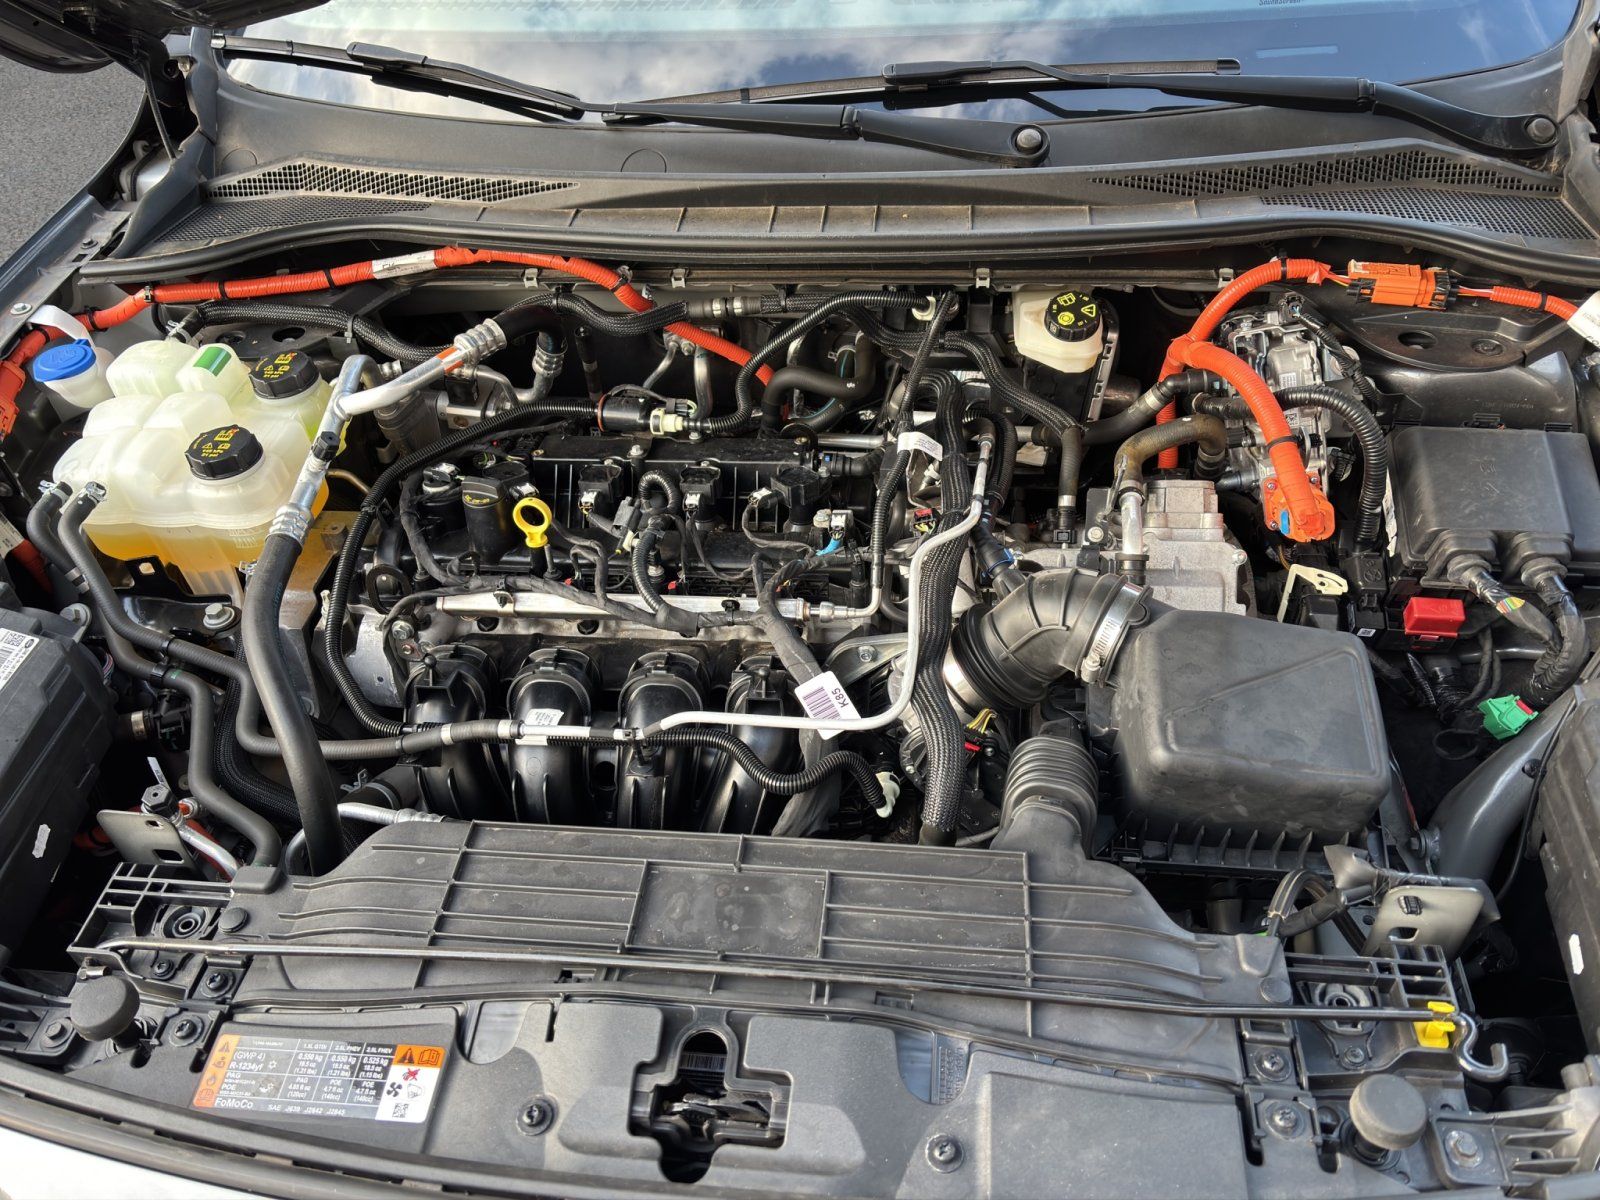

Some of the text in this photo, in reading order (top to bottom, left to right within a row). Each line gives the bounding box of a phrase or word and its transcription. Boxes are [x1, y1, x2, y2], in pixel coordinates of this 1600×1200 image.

[831, 687, 850, 708] K85
[233, 1051, 266, 1062] (GWP 4)
[314, 1054, 324, 1062] kg
[348, 1055, 357, 1064] kg
[362, 1056, 389, 1066] 0.525 kg
[229, 1061, 264, 1072] R-1234yf
[221, 1083, 237, 1091] POE
[214, 1097, 254, 1109] FoMoCo
